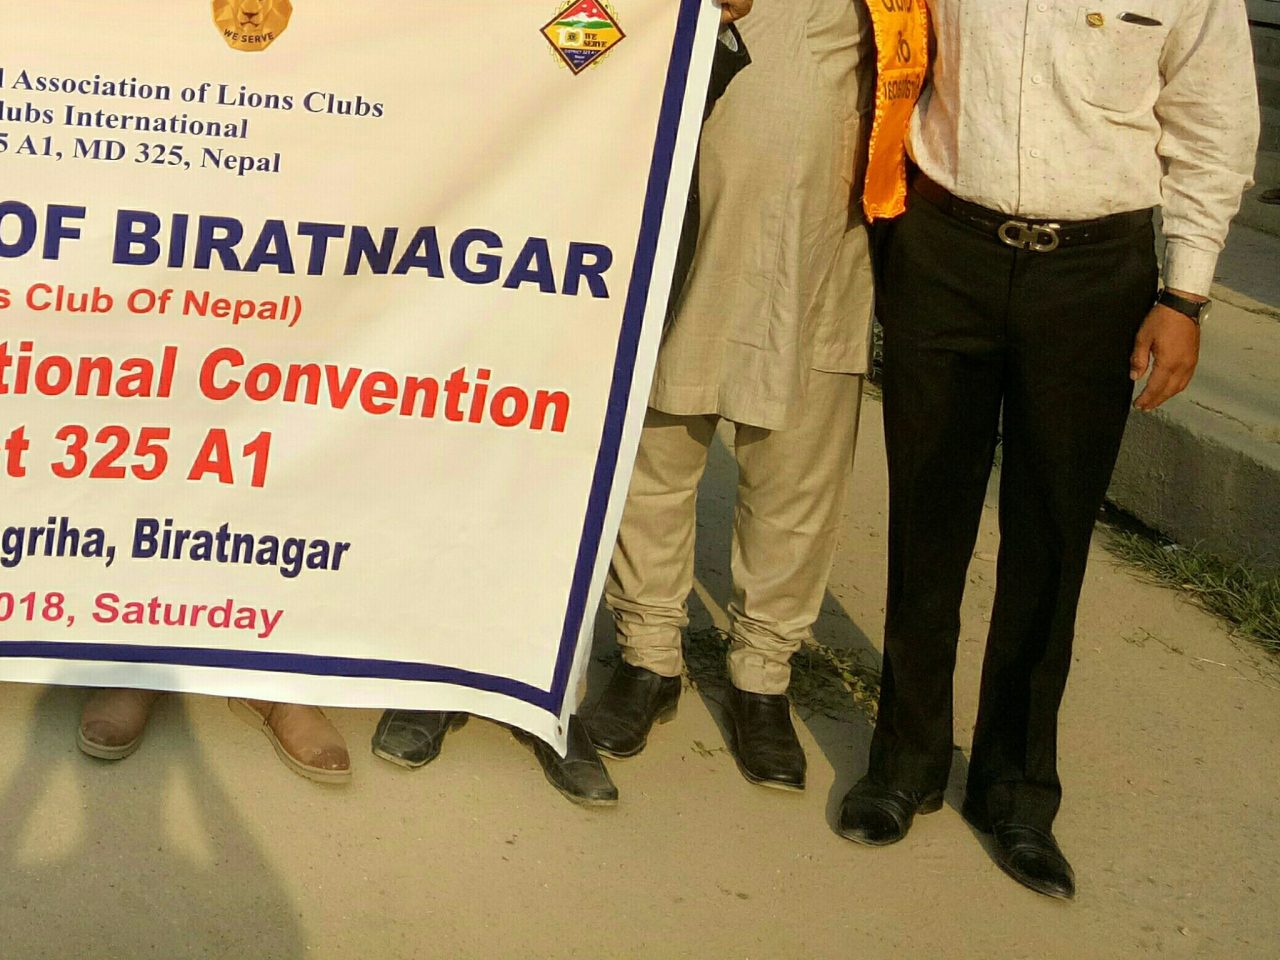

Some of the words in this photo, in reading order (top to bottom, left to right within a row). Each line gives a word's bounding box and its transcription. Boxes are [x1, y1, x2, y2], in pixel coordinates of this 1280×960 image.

[224, 28, 238, 40] WE
[241, 31, 274, 43] SERVE
[583, 40, 608, 48] SERVE
[584, 33, 598, 41] WE
[11, 70, 170, 102] Association
[181, 82, 211, 103] of
[218, 84, 293, 111] Lions
[303, 91, 384, 118] Clubs
[65, 105, 248, 139] International
[16, 135, 63, 160] A1,
[73, 138, 126, 161] MD
[134, 142, 191, 169] 325,
[201, 147, 281, 176] Nepal
[112, 209, 613, 299] BIRATNAGAR
[25, 283, 114, 314] Club
[127, 288, 173, 315] Of
[182, 290, 303, 326] Nepal)
[199, 347, 570, 433] Convention
[51, 424, 171, 481] 325
[188, 427, 272, 489] A1
[131, 517, 351, 579] Biratnagar
[92, 592, 283, 639] Saturday
